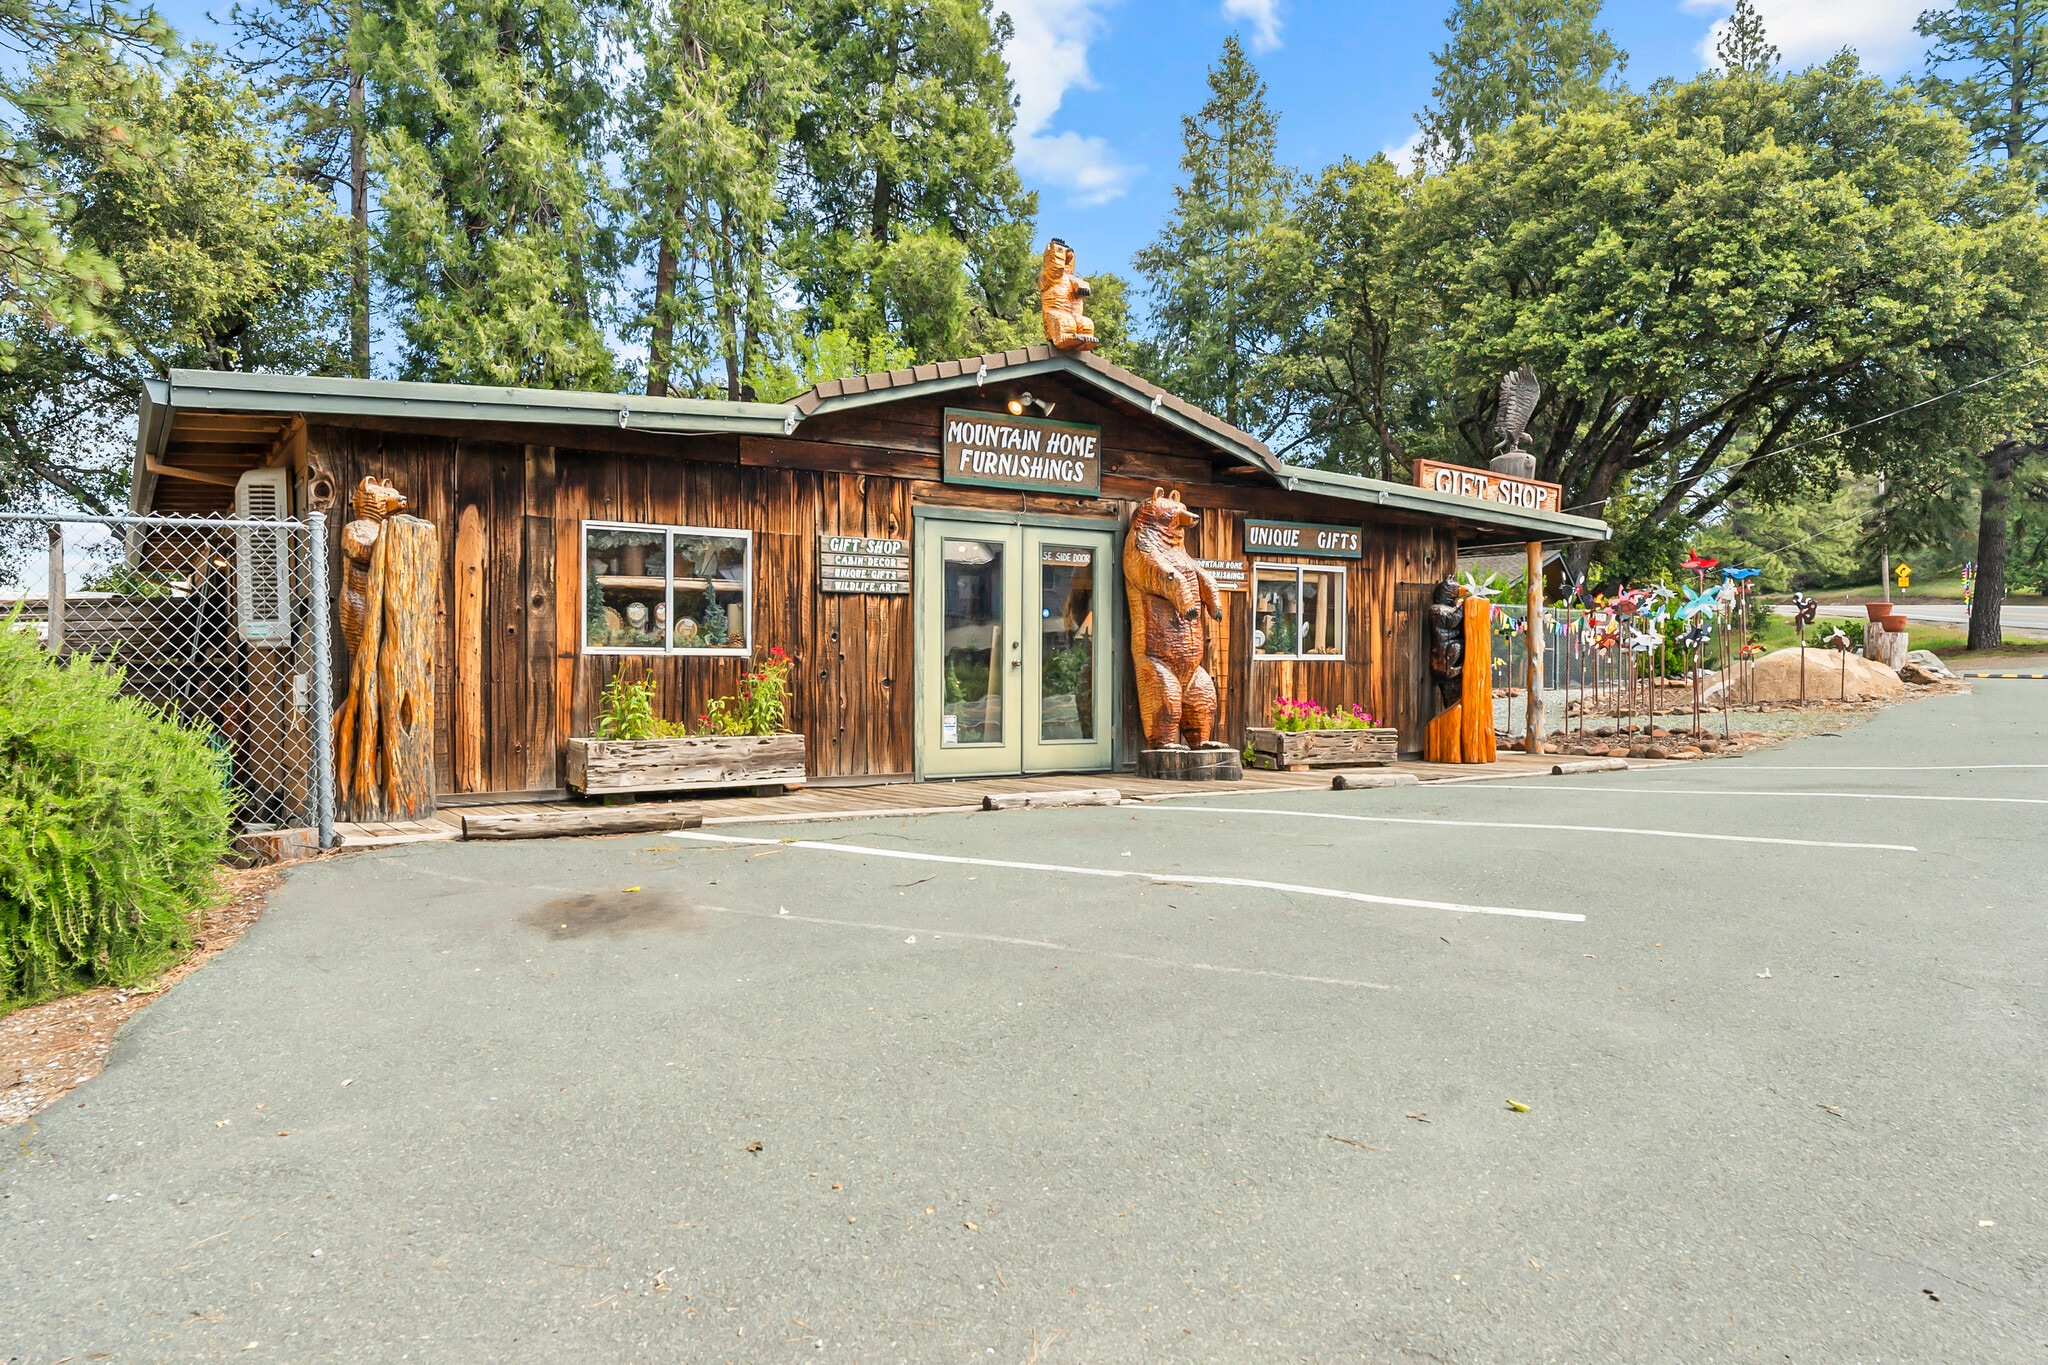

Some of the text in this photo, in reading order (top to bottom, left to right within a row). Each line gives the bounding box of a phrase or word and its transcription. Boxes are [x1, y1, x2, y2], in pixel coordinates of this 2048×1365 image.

[948, 421, 1097, 459] MOUNTAIN HOME
[959, 449, 1085, 482] FURNISHINGS
[1435, 468, 1548, 510] GIFT SHOP
[829, 537, 902, 555] GIFT SHOP
[1250, 526, 1358, 551] UNIQUE GIFTS
[835, 555, 897, 568] CABIN DECOR
[1042, 551, 1091, 563] SE SIDE DOOR
[1225, 561, 1244, 570] HOME
[834, 568, 897, 580] UNIQUE GIFTS
[834, 581, 898, 593] WILDLIFE ART
